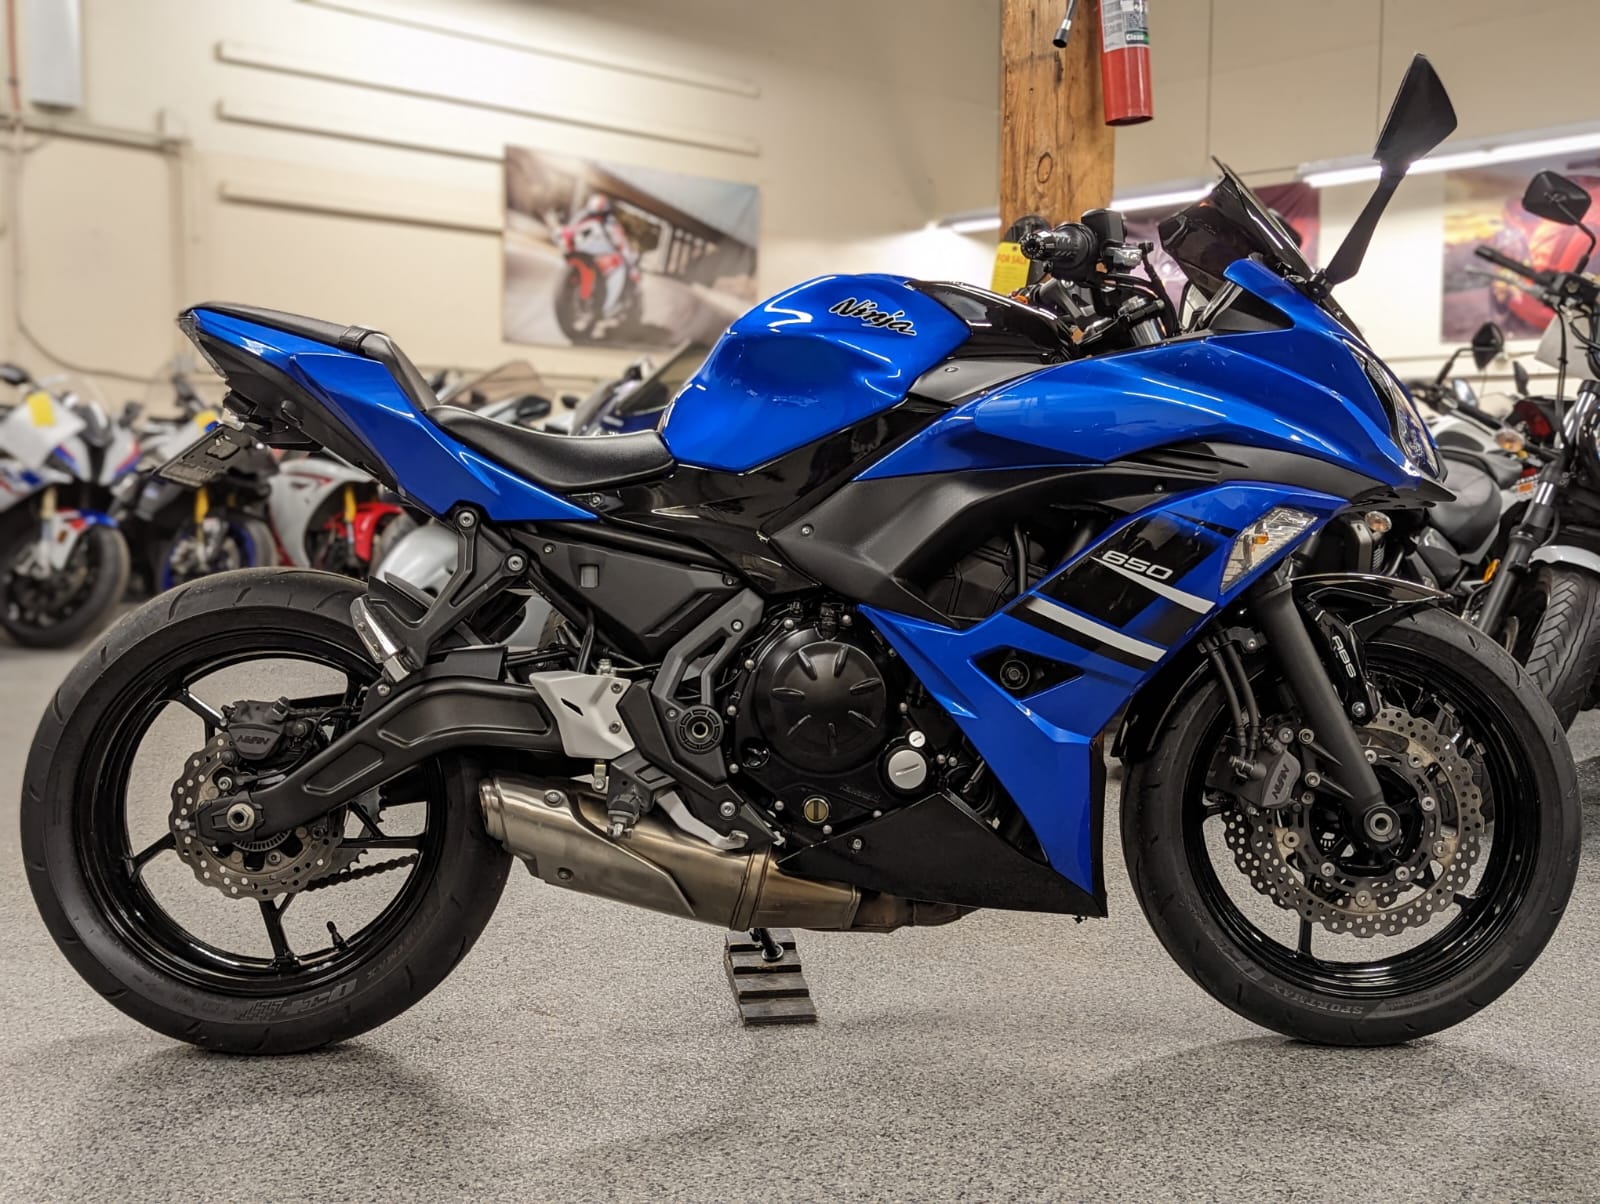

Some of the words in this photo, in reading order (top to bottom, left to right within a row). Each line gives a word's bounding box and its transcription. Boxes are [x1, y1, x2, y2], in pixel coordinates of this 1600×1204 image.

[828, 297, 917, 336] Ninja
[1102, 550, 1174, 580] 650
[1331, 635, 1357, 678] ABS
[1269, 982, 1365, 1015] SPORTMAX
